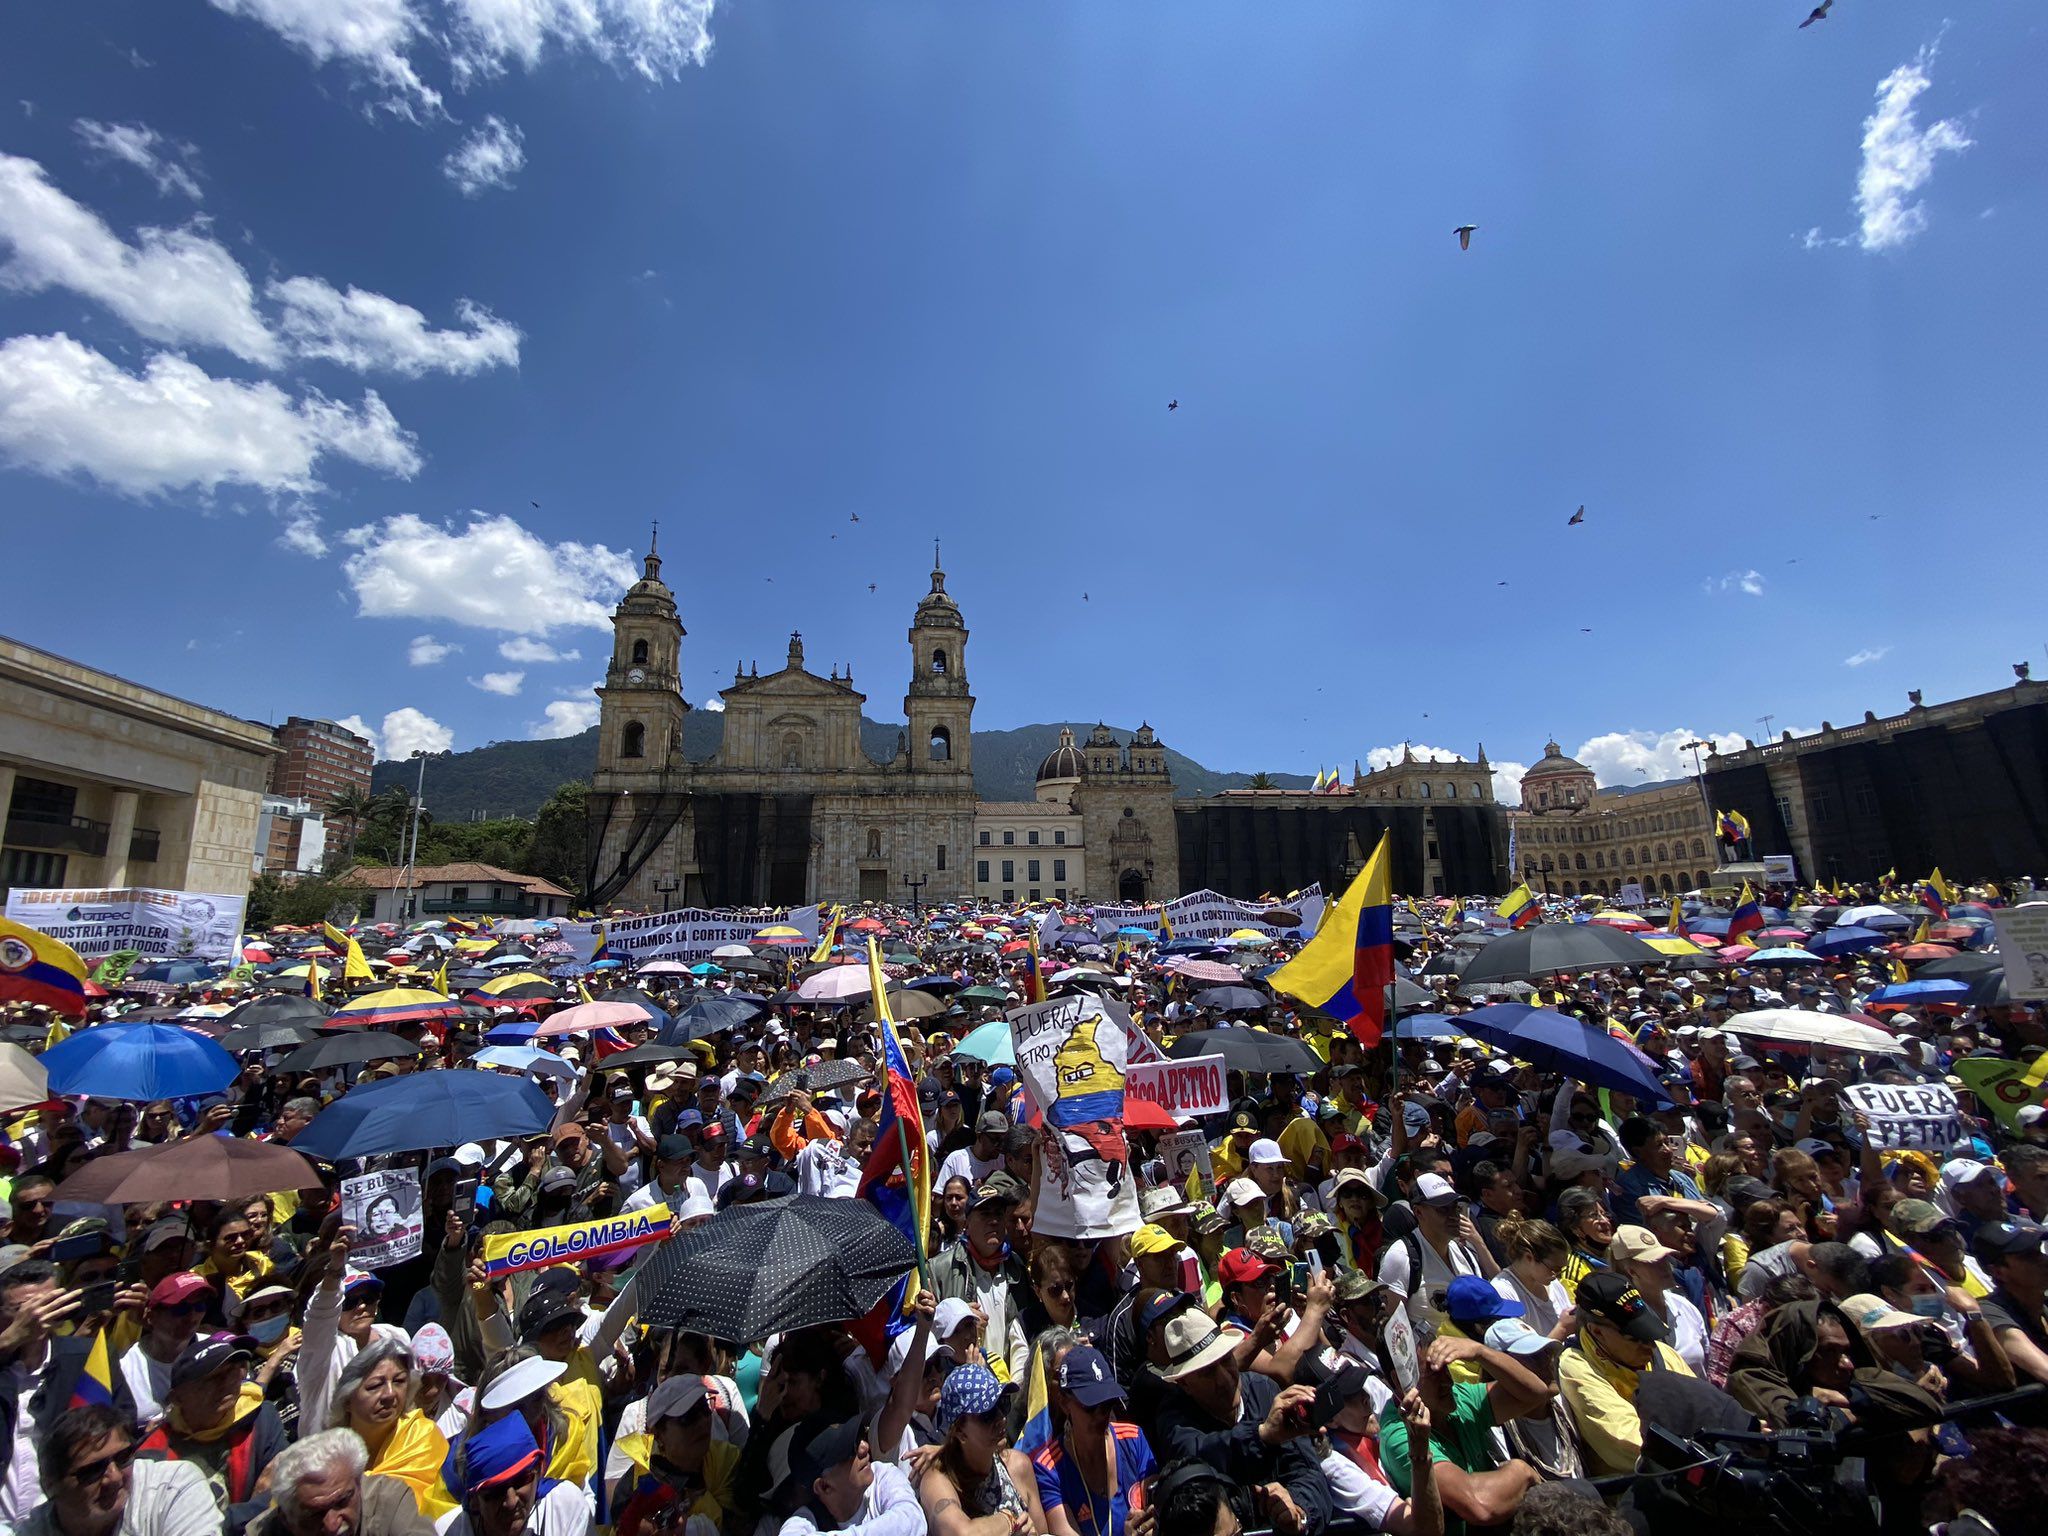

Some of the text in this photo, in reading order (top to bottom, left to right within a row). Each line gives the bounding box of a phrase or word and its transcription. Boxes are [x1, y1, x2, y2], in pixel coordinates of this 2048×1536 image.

[1178, 915, 1189, 924] DE
[1190, 912, 1200, 921] LA
[106, 923, 169, 940] PETROLERA
[608, 931, 673, 951] ROTEJAMOS
[676, 930, 688, 944] LA
[692, 929, 727, 942] CORTE
[114, 939, 128, 952] DE
[131, 939, 168, 954] TODOS
[1010, 997, 1084, 1043] FUERA!
[1015, 1044, 1050, 1072] PETRO
[1856, 1085, 1958, 1115] FUERA
[1174, 1133, 1203, 1146] BUSCA
[1877, 1118, 1962, 1146] PETRO
[344, 1172, 413, 1196] SE BUSCA
[507, 1215, 654, 1268] COLOMBIA
